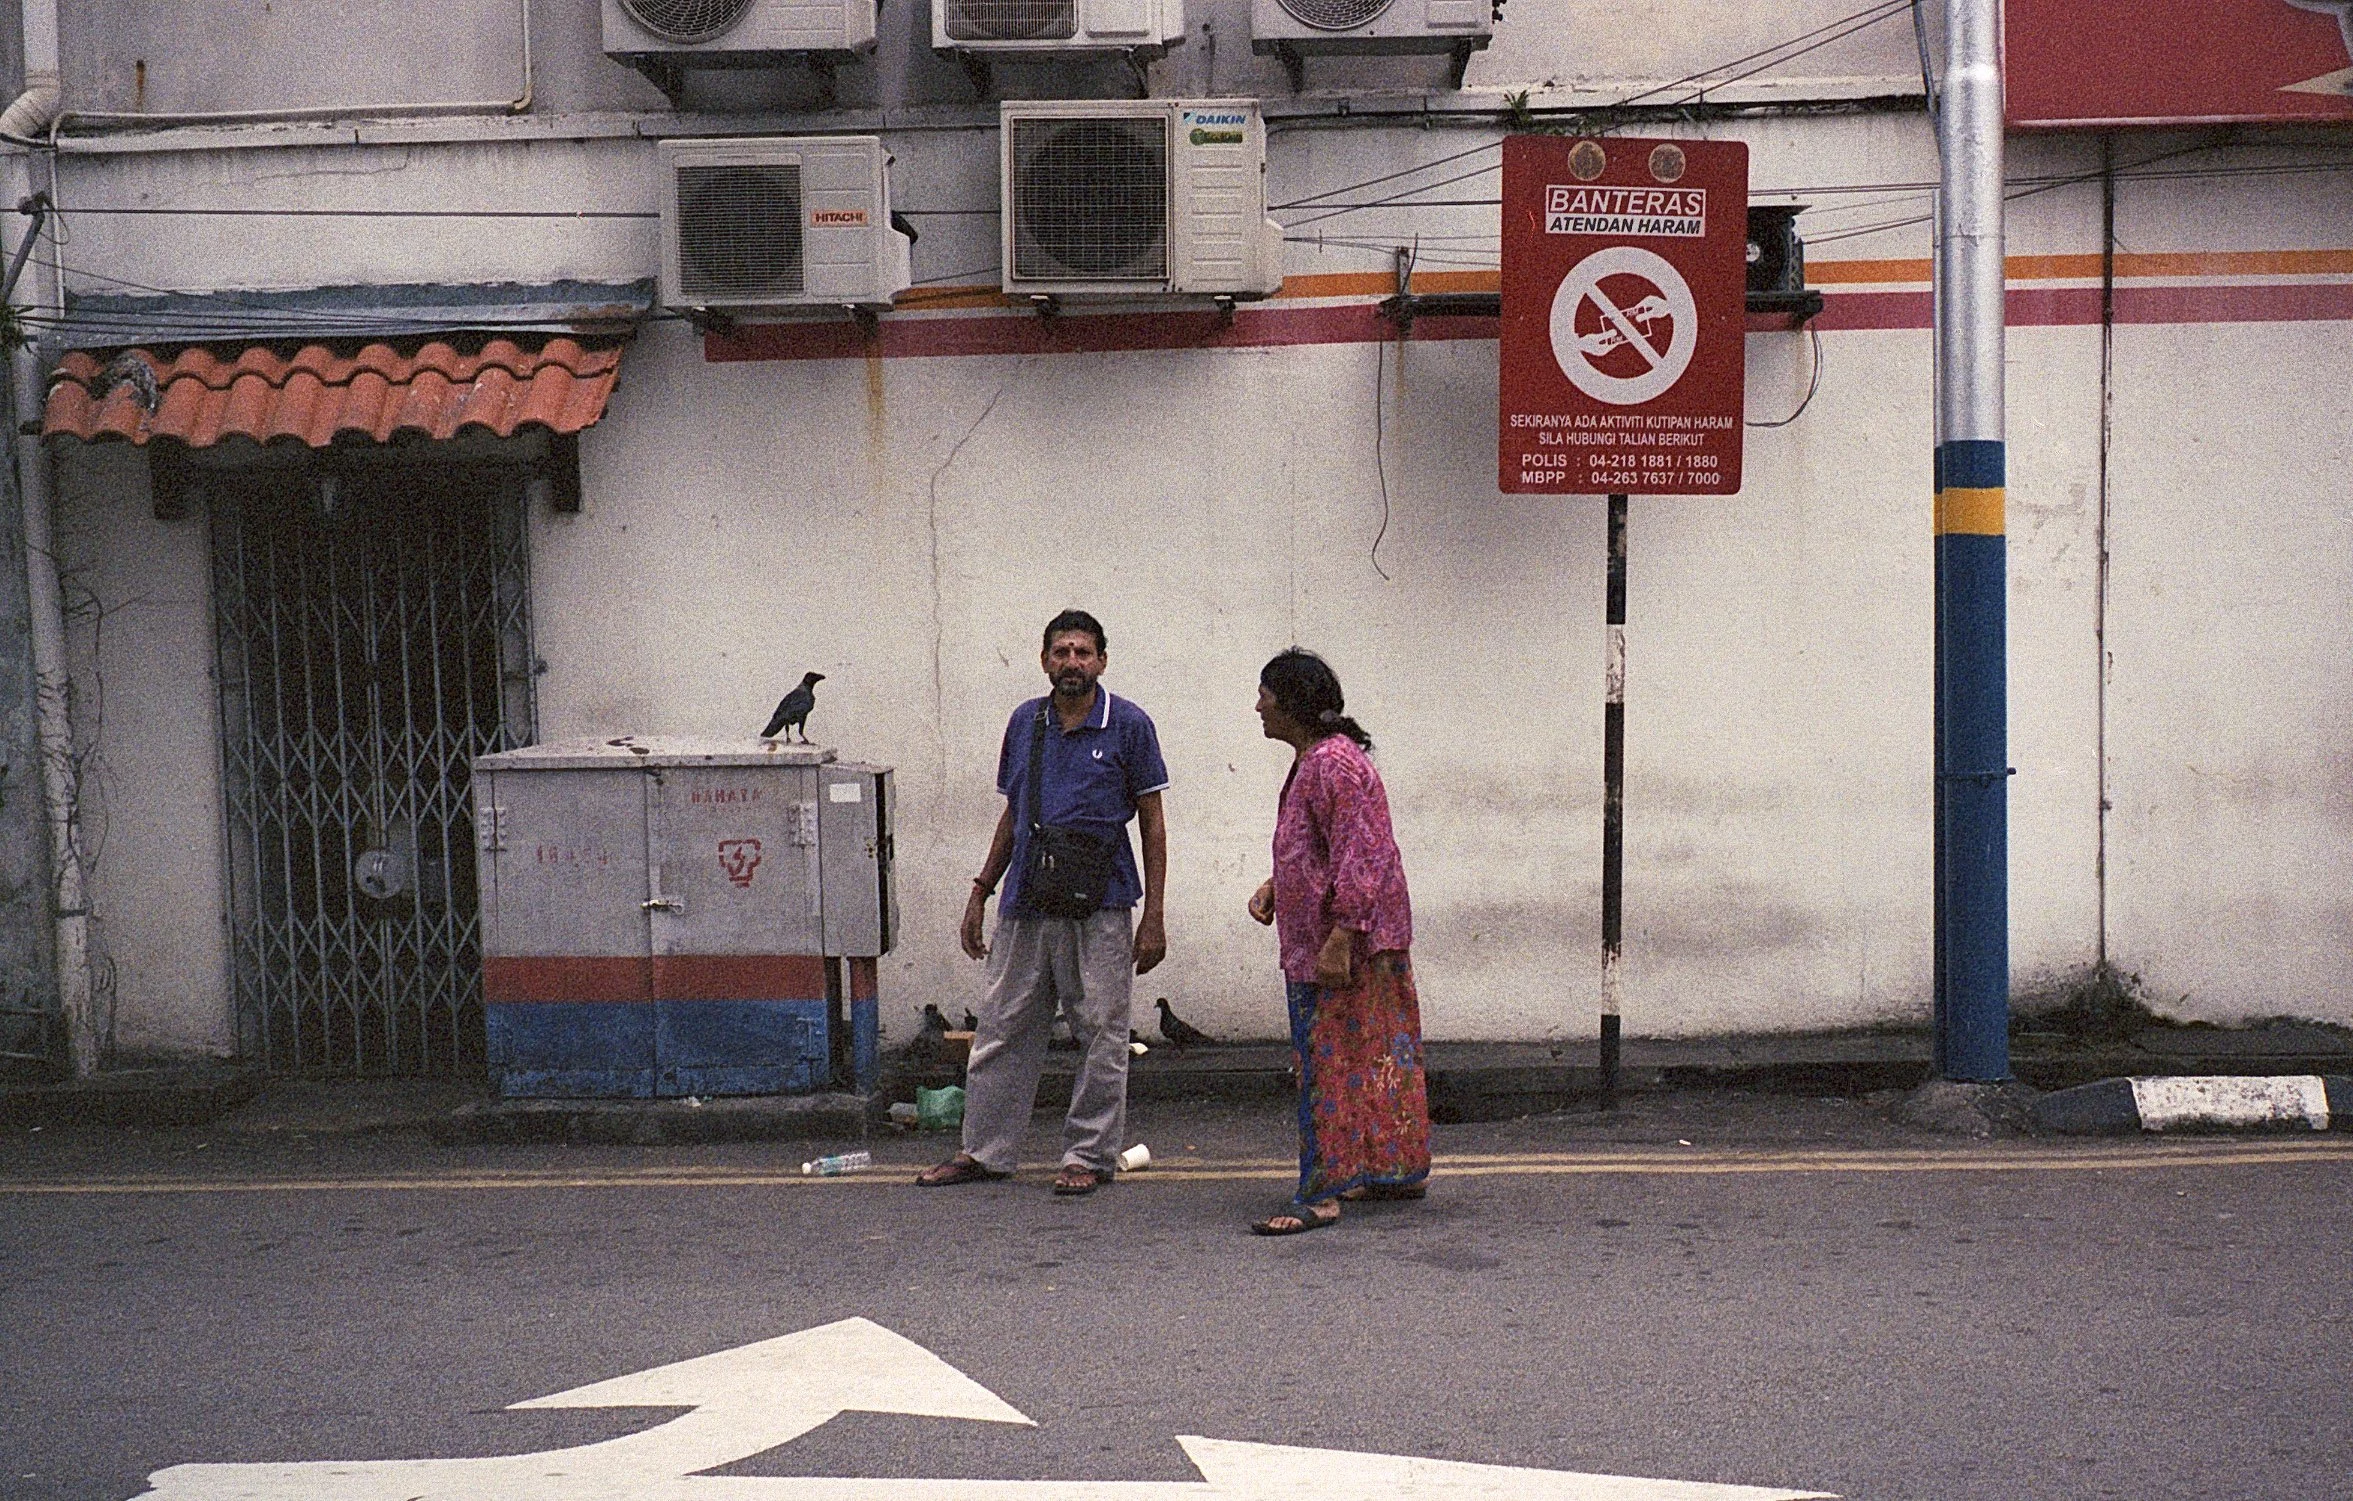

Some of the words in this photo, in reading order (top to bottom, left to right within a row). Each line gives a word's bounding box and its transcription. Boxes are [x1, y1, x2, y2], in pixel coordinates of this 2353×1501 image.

[1196, 114, 1246, 124] DAIKIN
[1550, 189, 1702, 215] BANTERAS
[815, 213, 863, 222] HITACHI
[1550, 216, 1633, 233] ATENDAN
[1637, 217, 1701, 234] HARAM
[1510, 414, 1572, 428] SEKIRANYA
[1574, 415, 1598, 428] ADA
[1599, 415, 1644, 429] AKTIVITI
[1646, 416, 1691, 429] KUTIPAN
[1694, 417, 1733, 429] HARAM
[1539, 432, 1564, 445] SILA
[1566, 432, 1616, 445] HUBUNGI
[1619, 432, 1656, 445] TALIAN
[1658, 433, 1705, 446] BERIKUT
[1522, 454, 1568, 467] POLIS
[1589, 454, 1636, 467] 04-218
[1641, 455, 1672, 468] 1881
[1686, 455, 1718, 468] 1880
[1522, 471, 1566, 484] MBPP
[1591, 471, 1638, 484] 04-263
[1643, 472, 1674, 484] 7637
[1687, 472, 1720, 485] 7000
